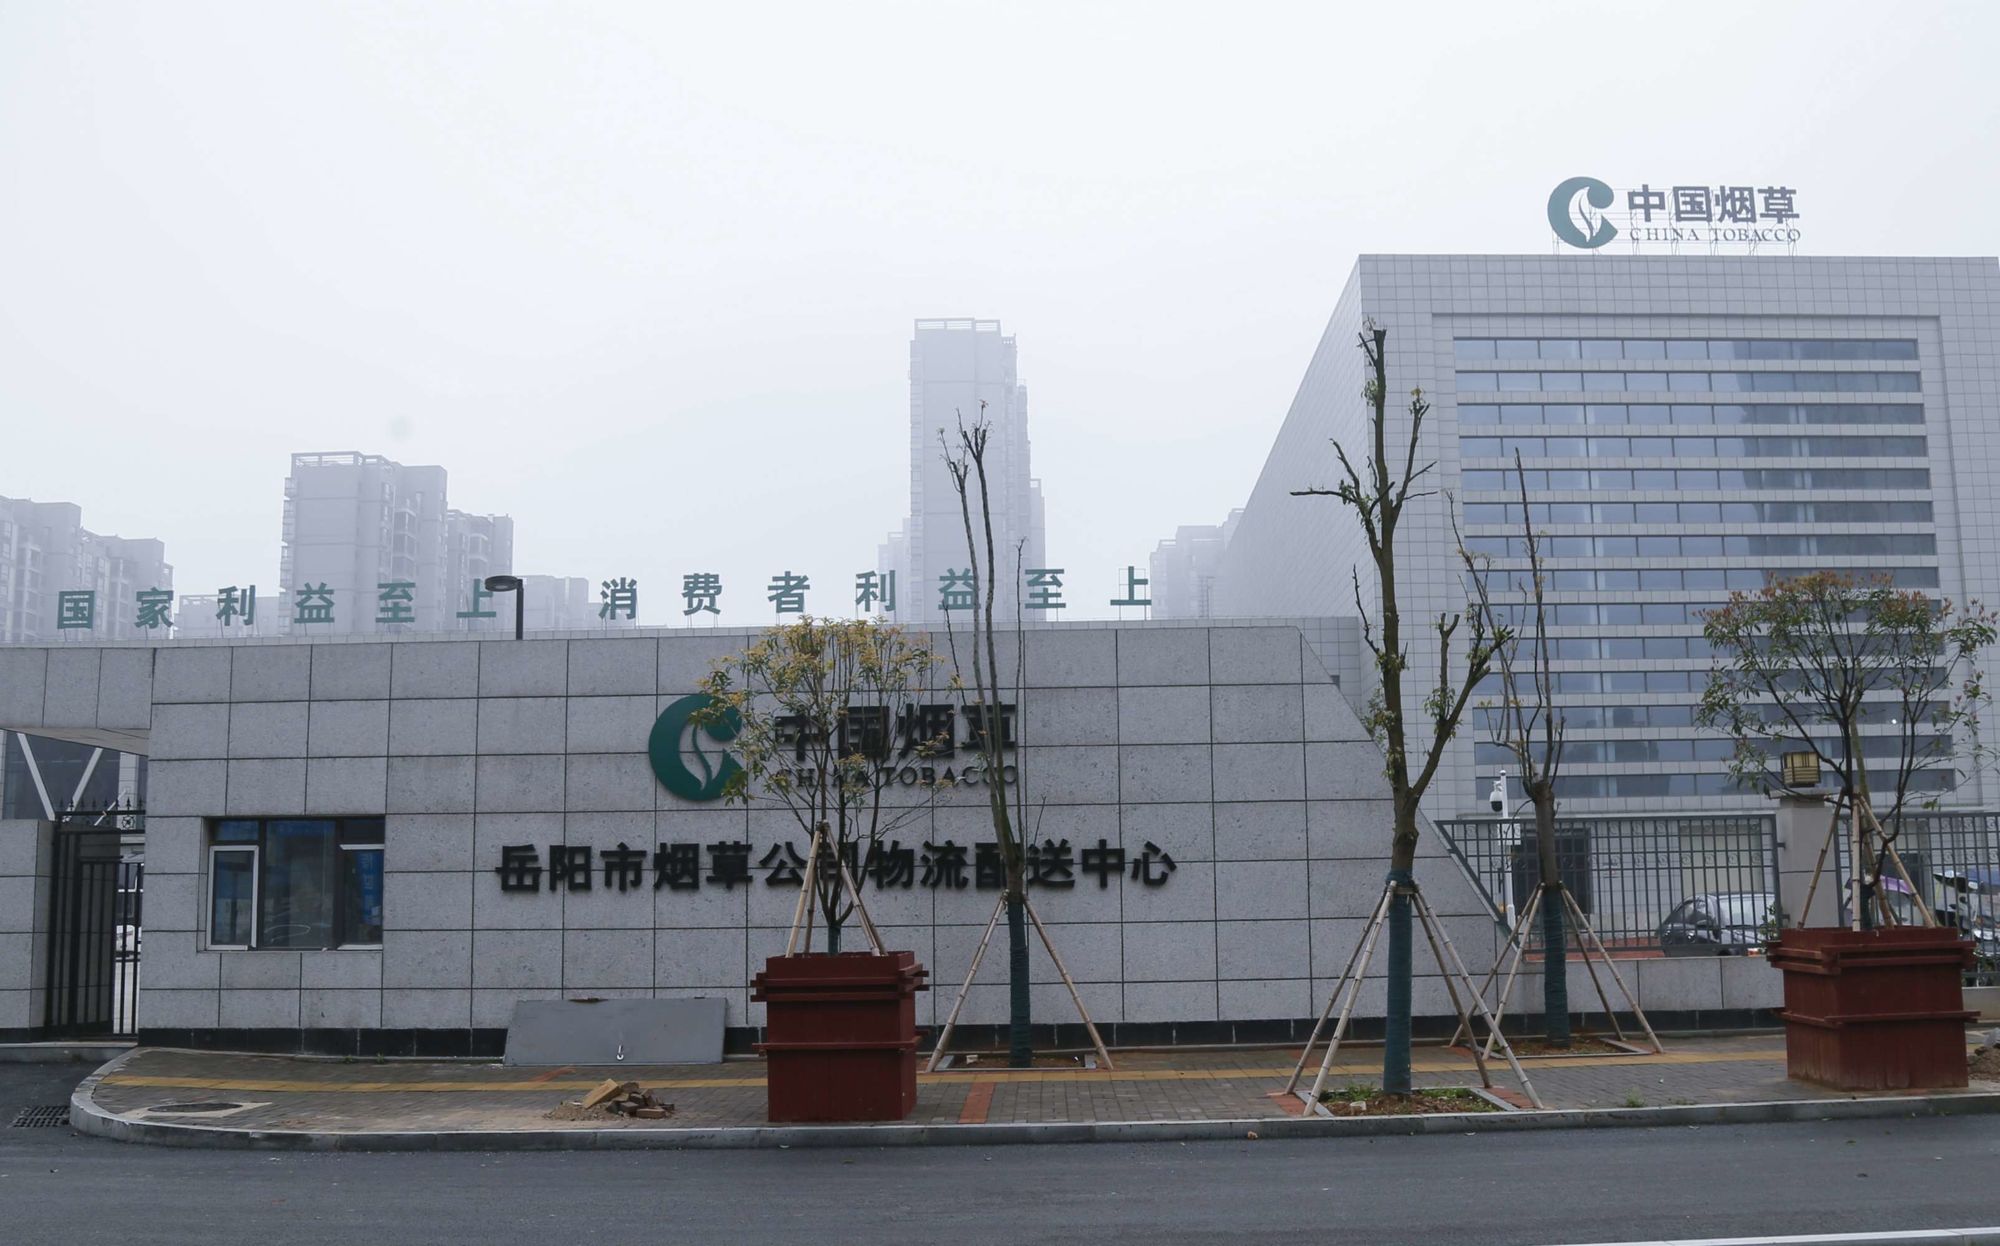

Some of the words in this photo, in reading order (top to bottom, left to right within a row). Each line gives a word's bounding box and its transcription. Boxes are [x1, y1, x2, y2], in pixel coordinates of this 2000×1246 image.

[1627, 184, 1800, 224] 中国烟草
[1630, 227, 1700, 242] CHINA
[1710, 227, 1801, 242] TOBACCO
[57, 578, 497, 629] 国家利益至上
[599, 566, 1152, 620] 消费者利益至上
